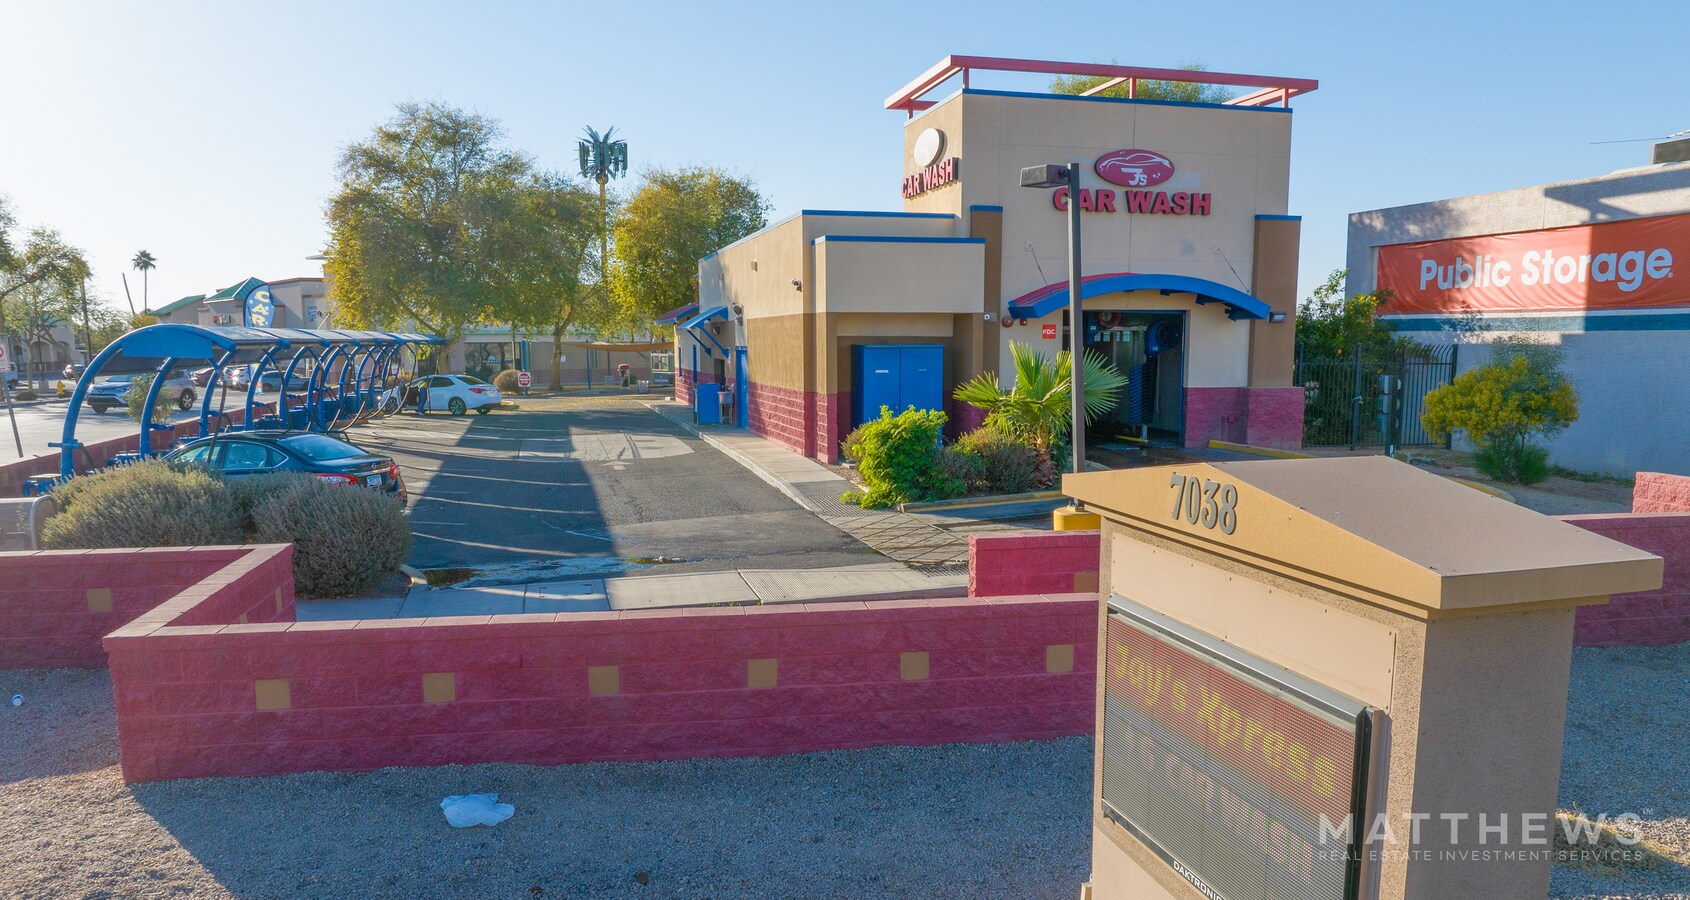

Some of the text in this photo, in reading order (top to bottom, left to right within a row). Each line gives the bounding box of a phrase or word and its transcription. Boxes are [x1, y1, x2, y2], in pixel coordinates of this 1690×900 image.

[901, 157, 959, 199] CAR WASH
[1052, 187, 1212, 216] CAR WASH
[1419, 247, 1673, 293] Public Storage
[251, 290, 270, 327] CAR
[1169, 471, 1239, 536] 7038
[1112, 642, 1338, 798] Jay's Xpress
